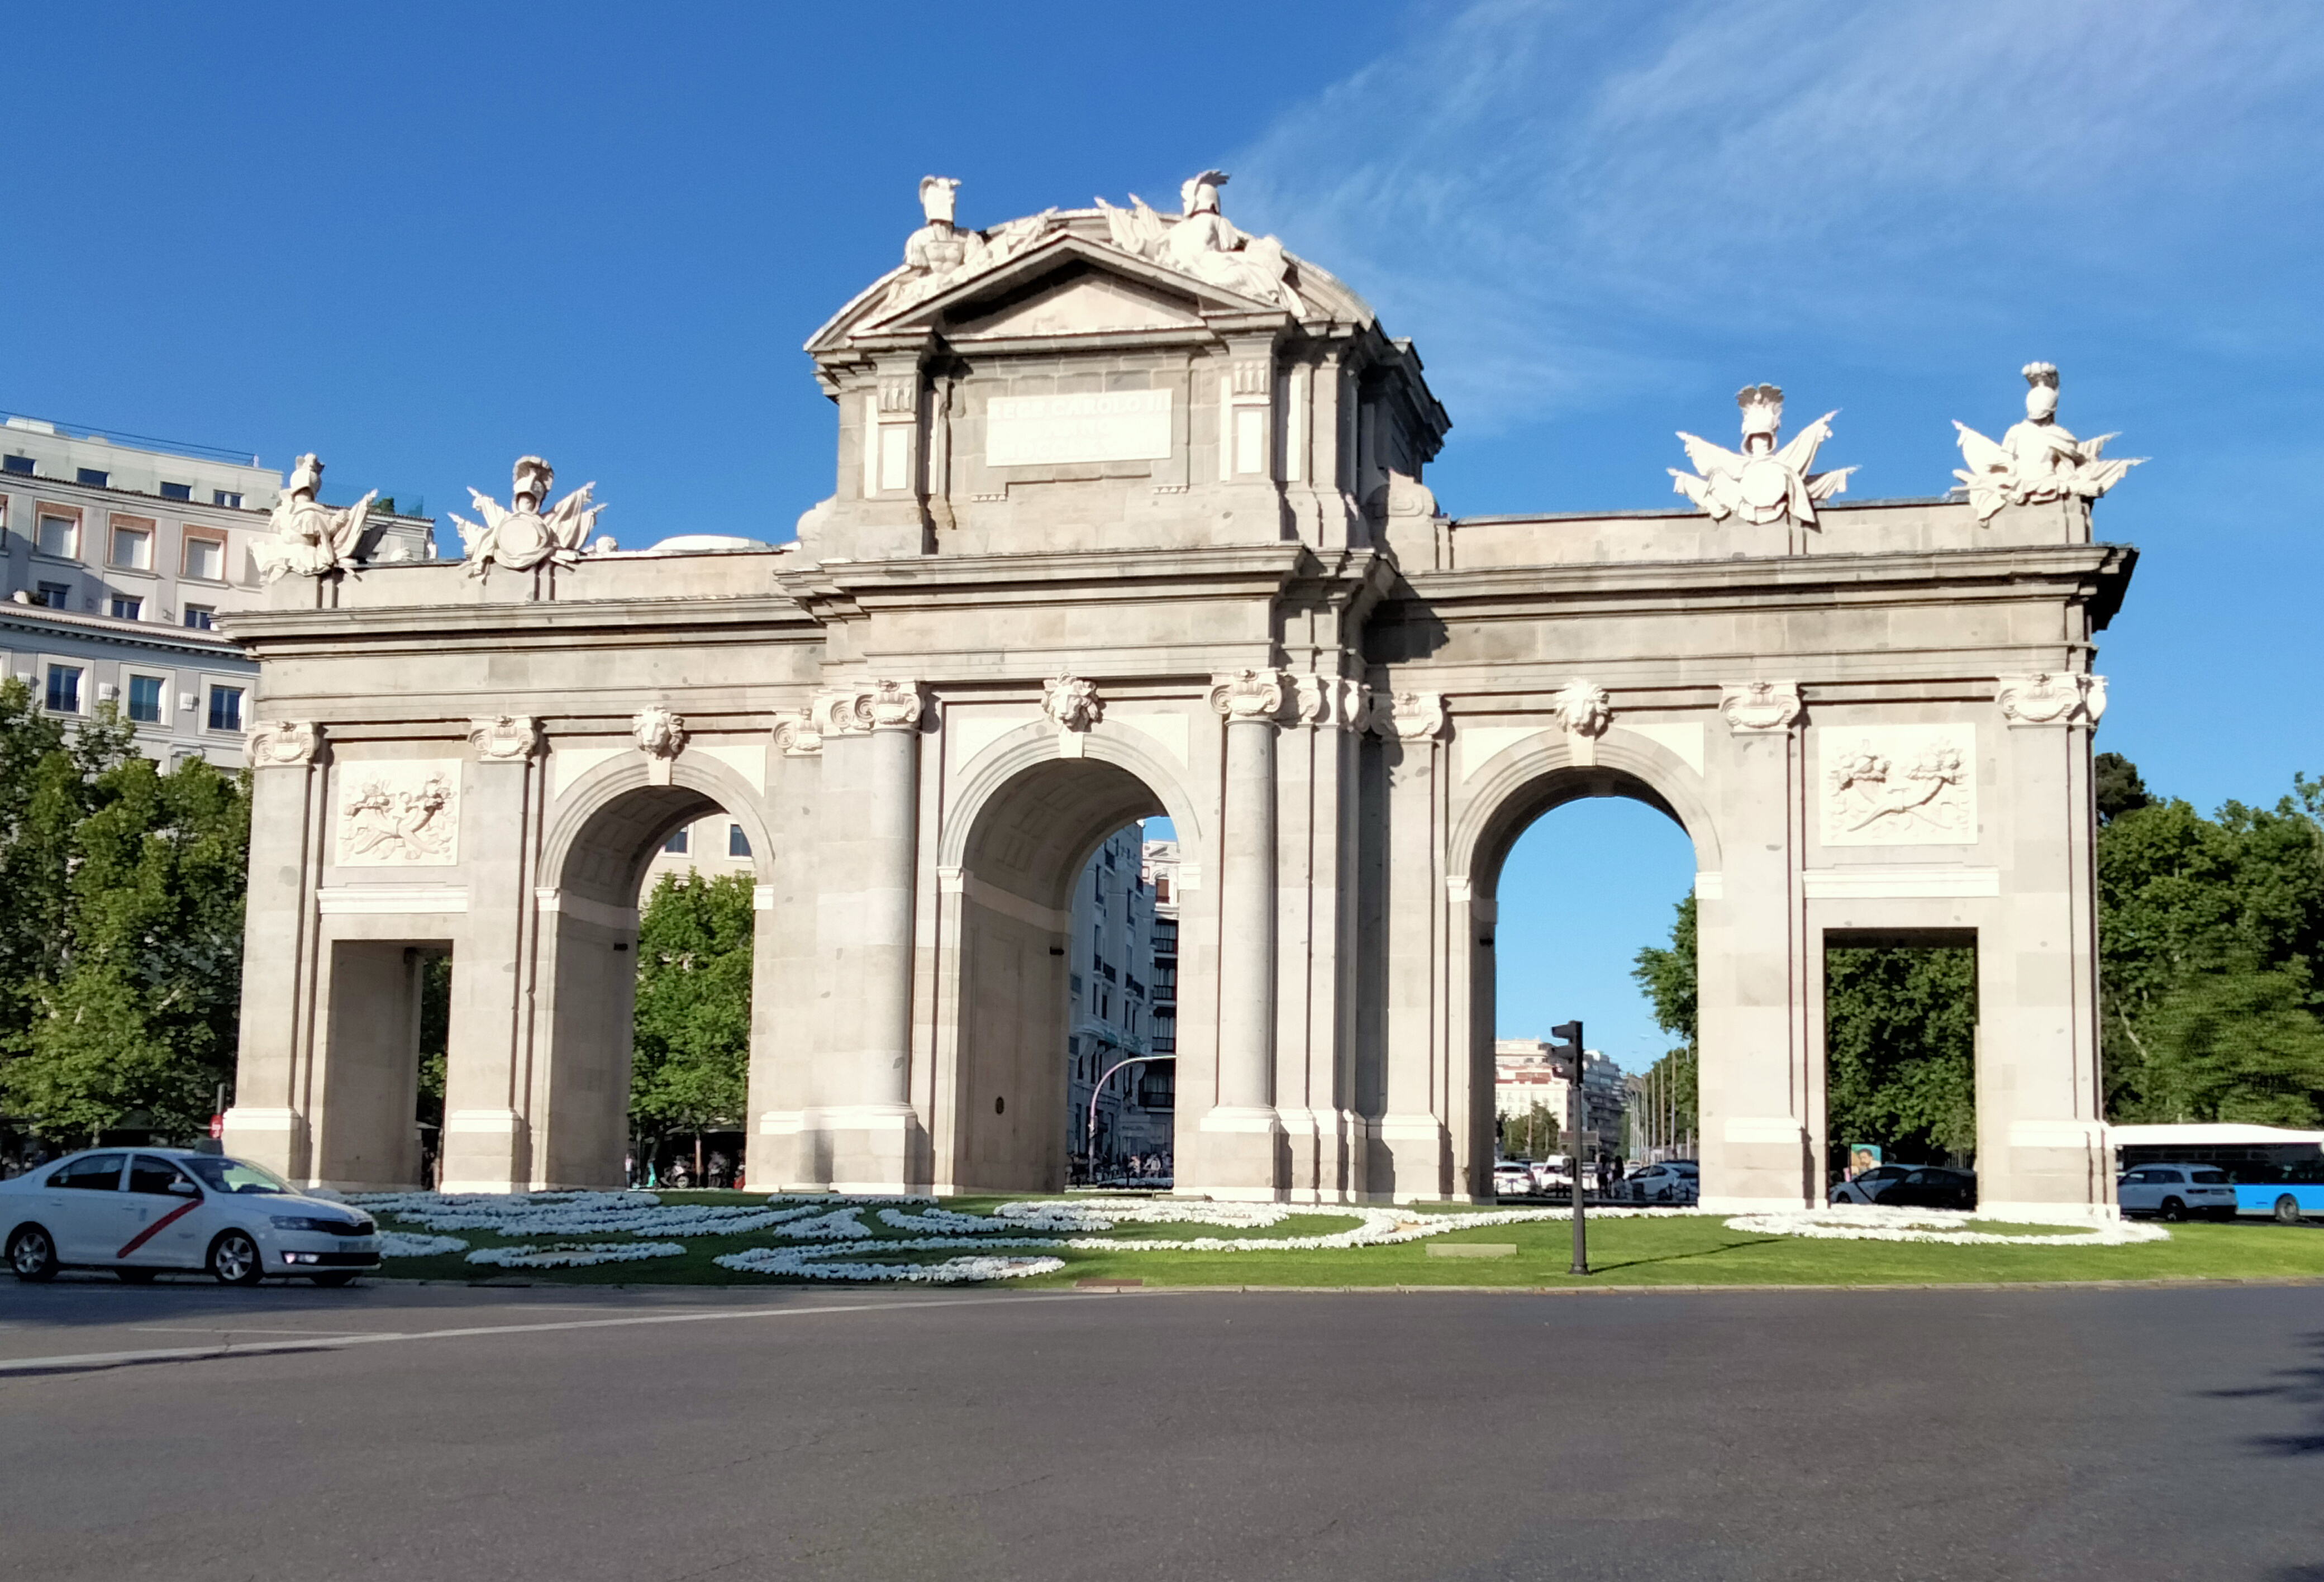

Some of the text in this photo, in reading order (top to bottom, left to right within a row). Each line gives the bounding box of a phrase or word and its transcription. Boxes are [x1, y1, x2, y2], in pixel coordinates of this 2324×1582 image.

[1051, 396, 1141, 416] CAROLO
[1147, 393, 1170, 411] III
[1045, 419, 1111, 437] ANNO
